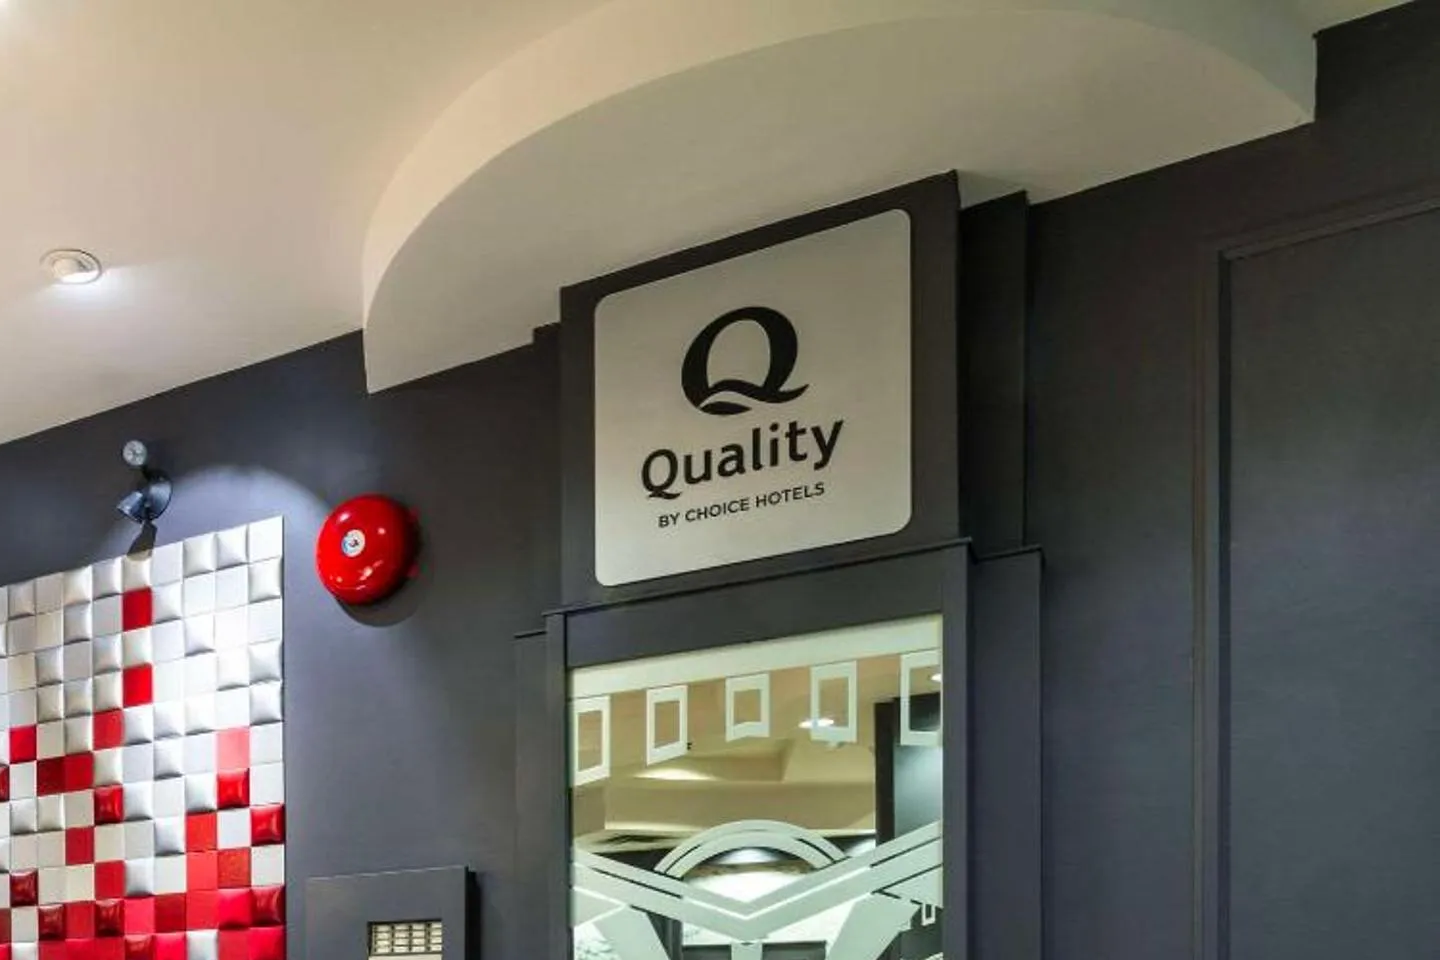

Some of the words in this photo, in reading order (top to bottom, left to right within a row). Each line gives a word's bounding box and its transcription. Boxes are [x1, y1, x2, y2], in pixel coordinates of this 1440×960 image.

[641, 420, 844, 500] Quality
[658, 513, 680, 528] BY
[685, 497, 750, 523] CHOICE
[756, 482, 825, 508] HOTELS
